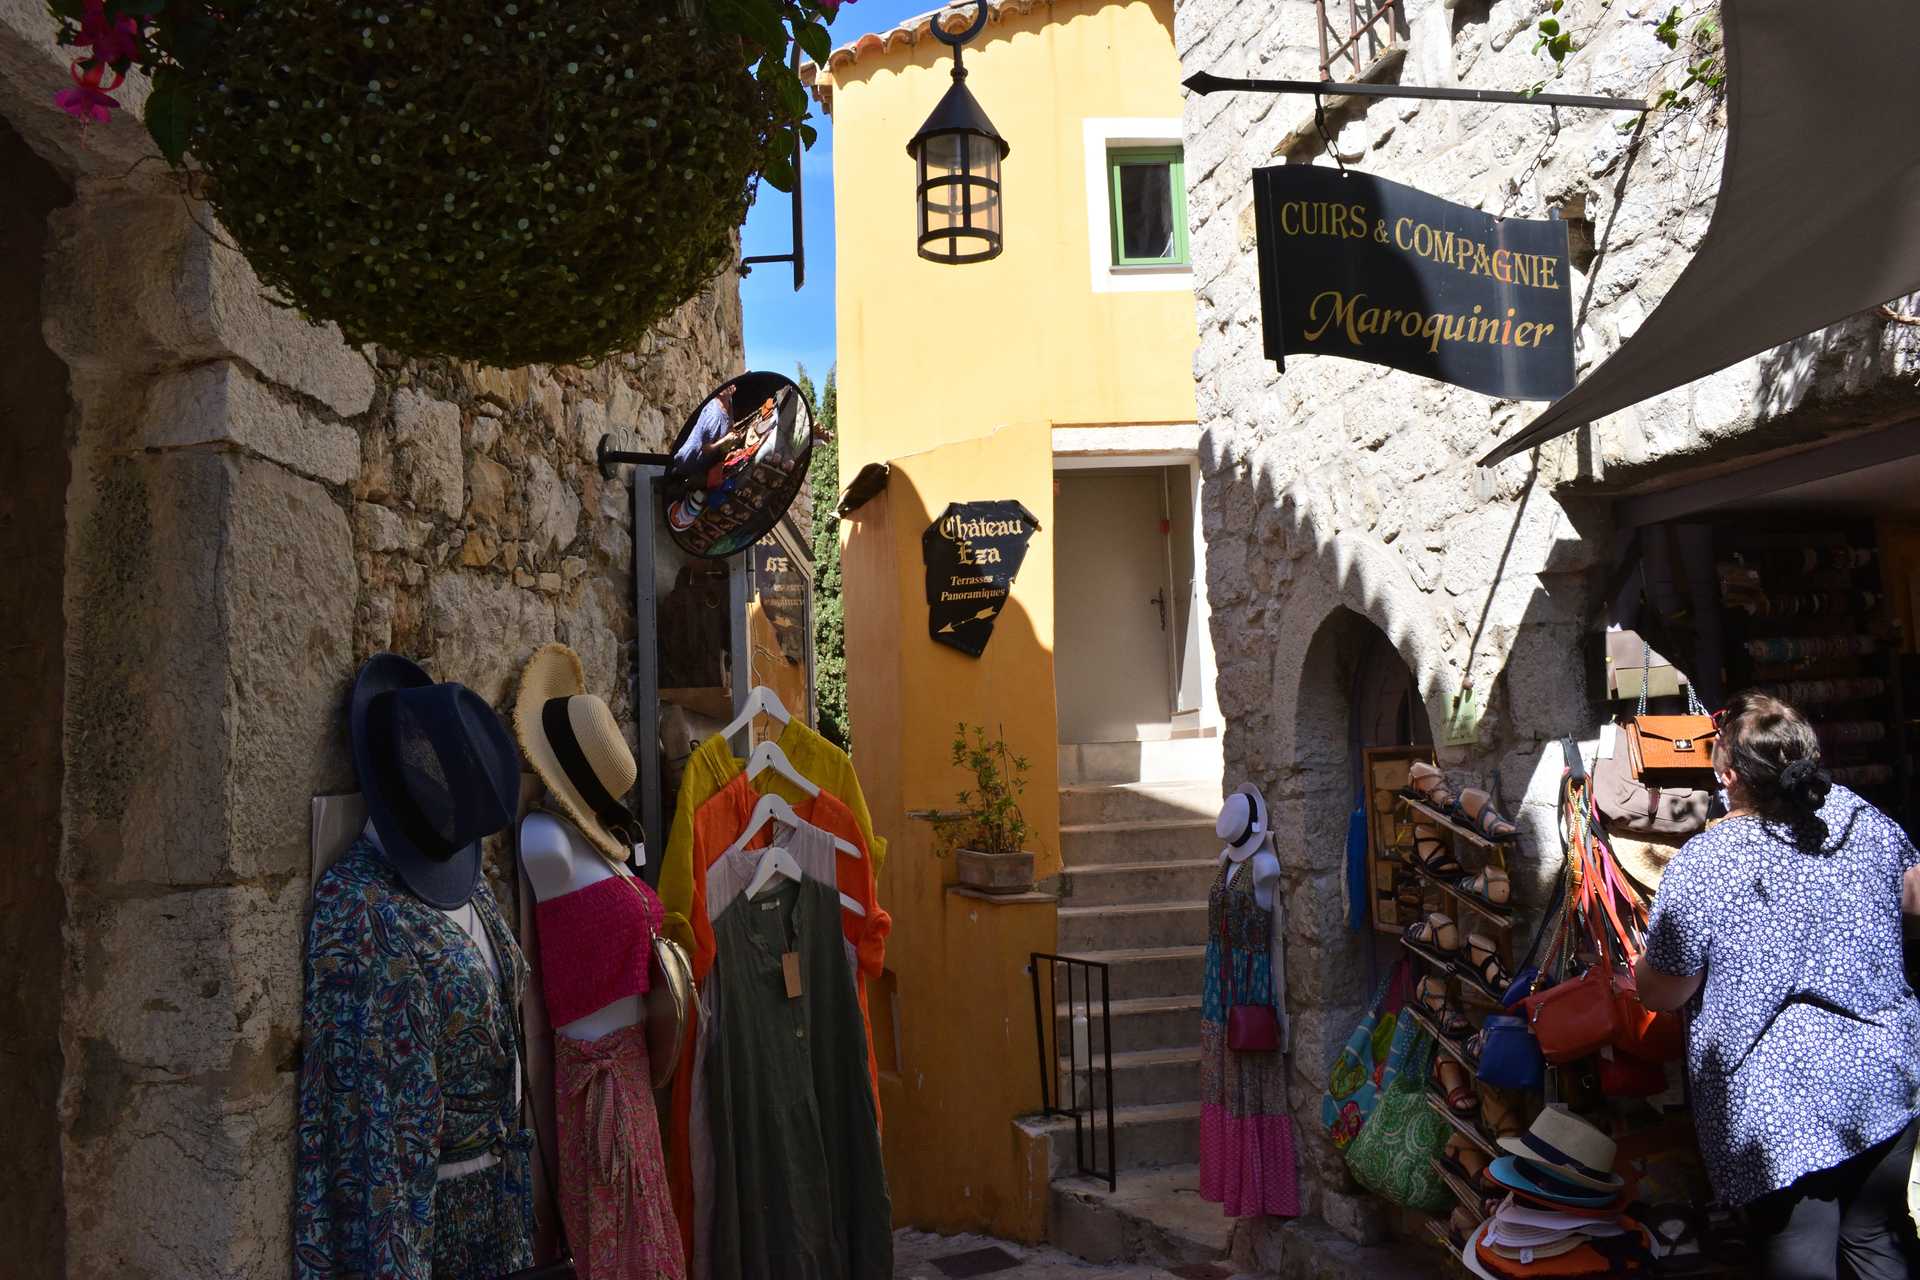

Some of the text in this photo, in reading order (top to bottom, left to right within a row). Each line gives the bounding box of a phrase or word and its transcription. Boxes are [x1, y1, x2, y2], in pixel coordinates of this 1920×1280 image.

[1281, 202, 1559, 289] CUIRS & COMPAGNIE
[1303, 290, 1554, 353] Maroquinier
[939, 514, 1024, 541] Château
[956, 540, 1002, 565] Eza
[950, 575, 994, 586] Terrasses
[940, 587, 1006, 603] Panoramiques
